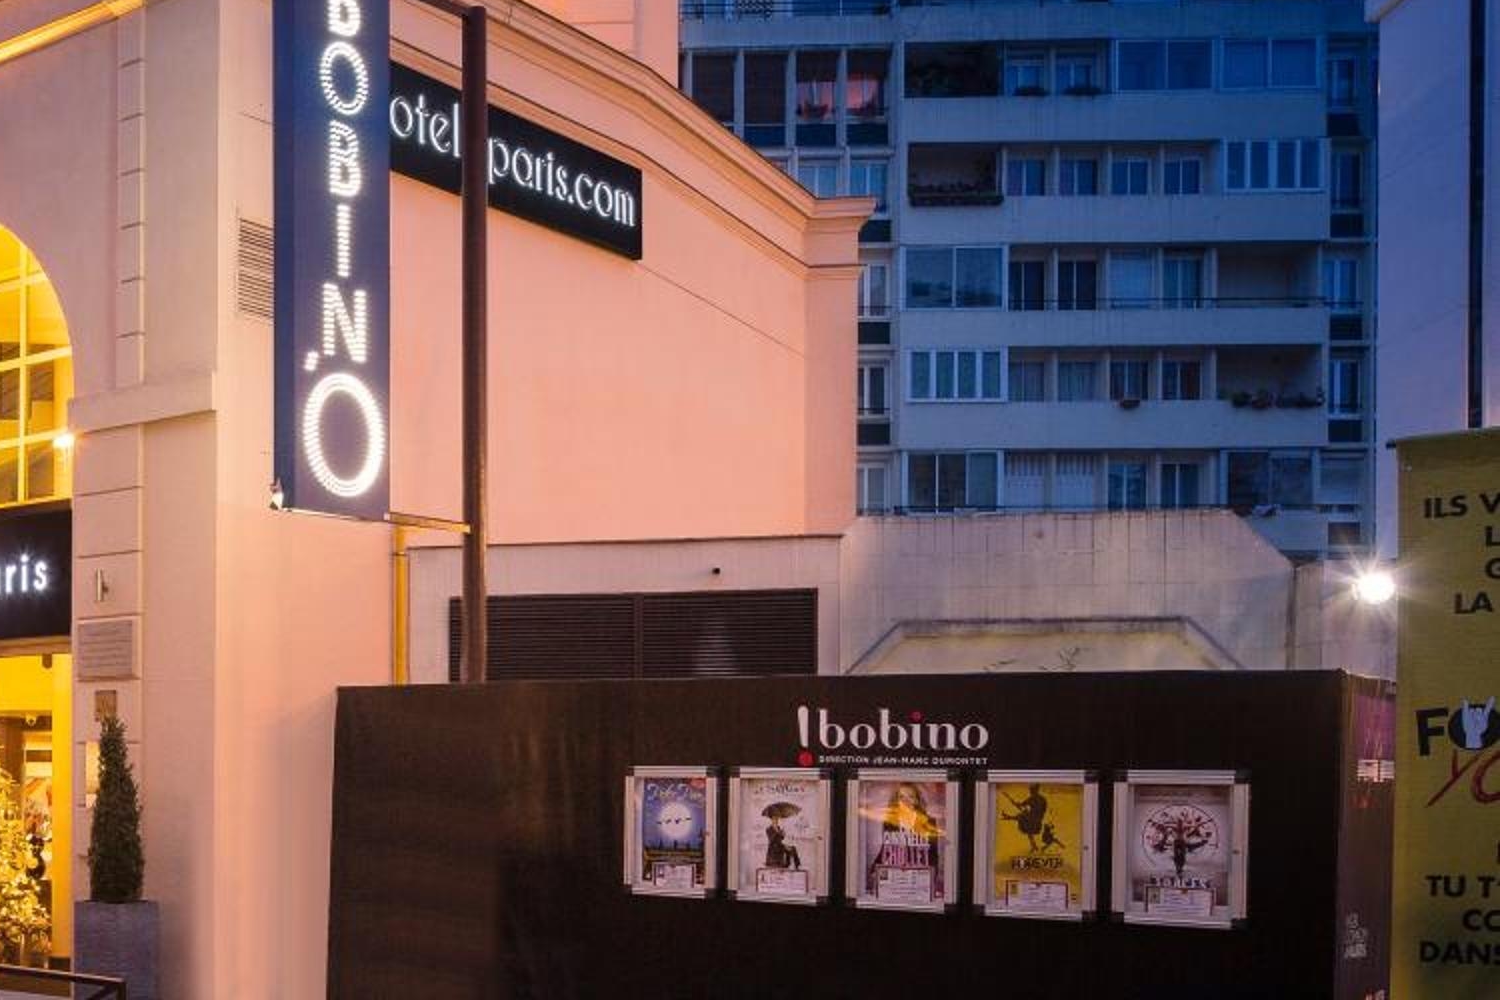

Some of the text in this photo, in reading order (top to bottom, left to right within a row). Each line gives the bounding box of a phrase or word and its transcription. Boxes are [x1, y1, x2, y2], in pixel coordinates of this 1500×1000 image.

[1423, 495, 1468, 518] ILS
[1455, 591, 1494, 614] LA
[1425, 875, 1466, 898] TU
